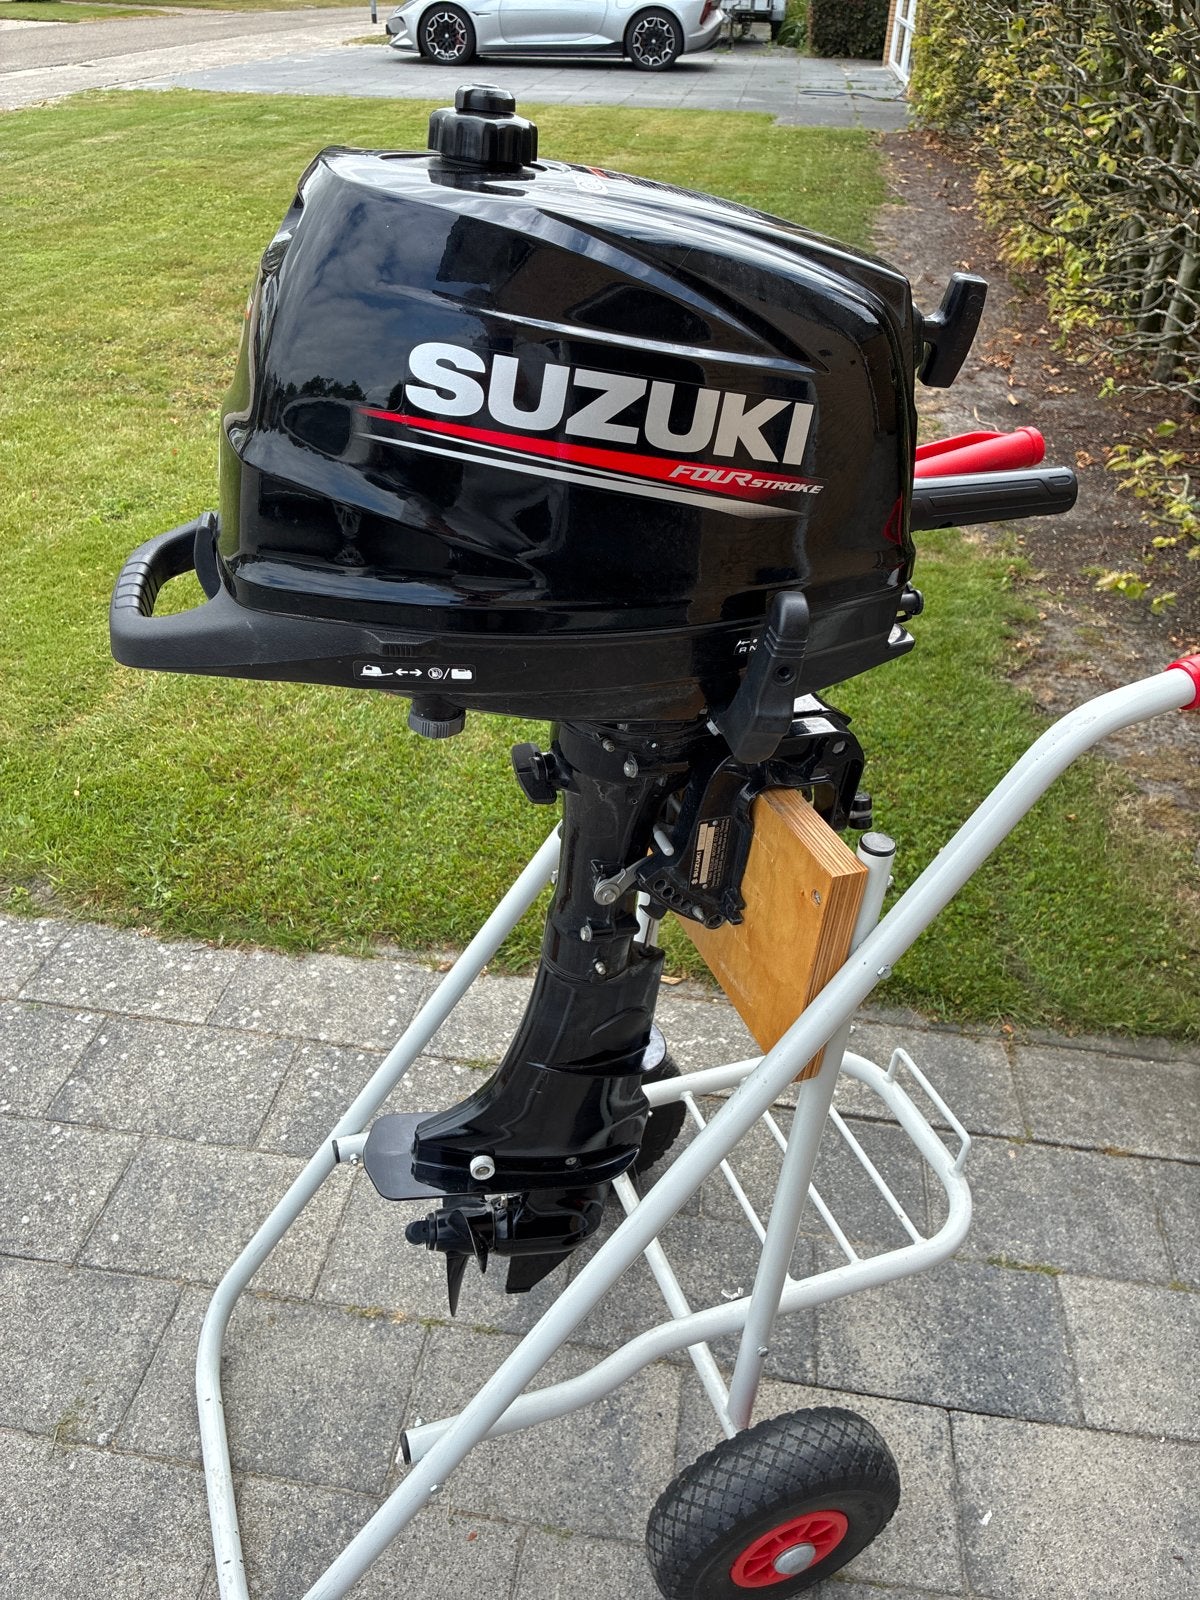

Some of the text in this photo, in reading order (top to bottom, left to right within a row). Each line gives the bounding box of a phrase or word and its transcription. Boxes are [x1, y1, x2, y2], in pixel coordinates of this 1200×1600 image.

[405, 342, 815, 466] SUZUKI
[668, 465, 824, 494] FOUR STROKE
[693, 851, 702, 878] SUZUKI
